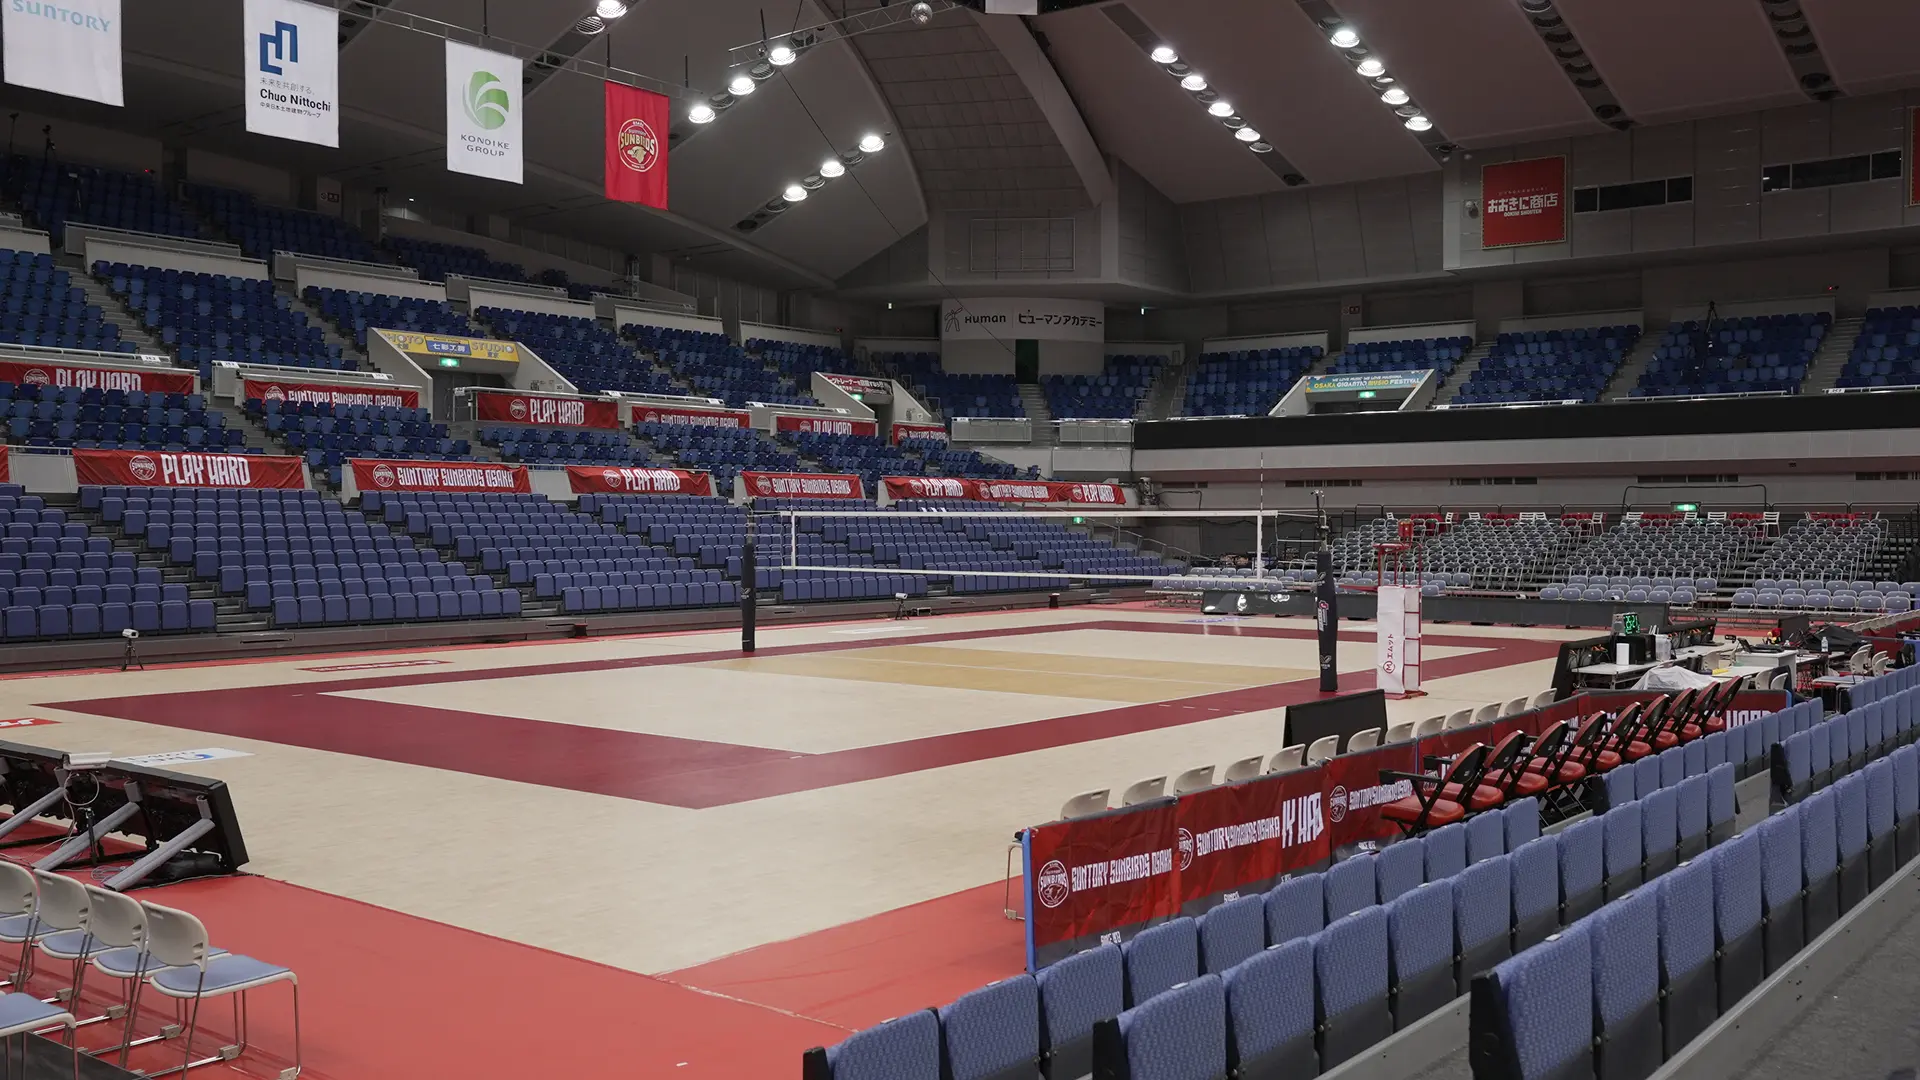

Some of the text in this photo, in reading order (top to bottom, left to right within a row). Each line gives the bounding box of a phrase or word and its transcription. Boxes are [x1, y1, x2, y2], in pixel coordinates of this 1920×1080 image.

[260, 88, 331, 112] Chuo Nittochi
[461, 134, 510, 149] KONOIKE
[466, 145, 505, 156] GROUP
[1487, 193, 1559, 213] おおきに商店
[965, 314, 1007, 324] Human
[1018, 313, 1103, 327] ヒューマンアカデミー
[530, 399, 585, 425] PLAY HARD
[161, 453, 251, 486] PLAY HARD
[397, 467, 515, 488] SUNTORY SUNBIRDS OSAKA
[620, 468, 681, 491] PLAY HARD
[920, 478, 944, 496] PLAY
[1081, 484, 1098, 502] PLAY
[1196, 827, 1230, 857] SUNTORY
[1257, 816, 1281, 841] OSAKA
[1071, 860, 1109, 893] SUNTORY
[1109, 853, 1150, 884] SUNBIRDS
[1151, 848, 1173, 876] OSAKA
